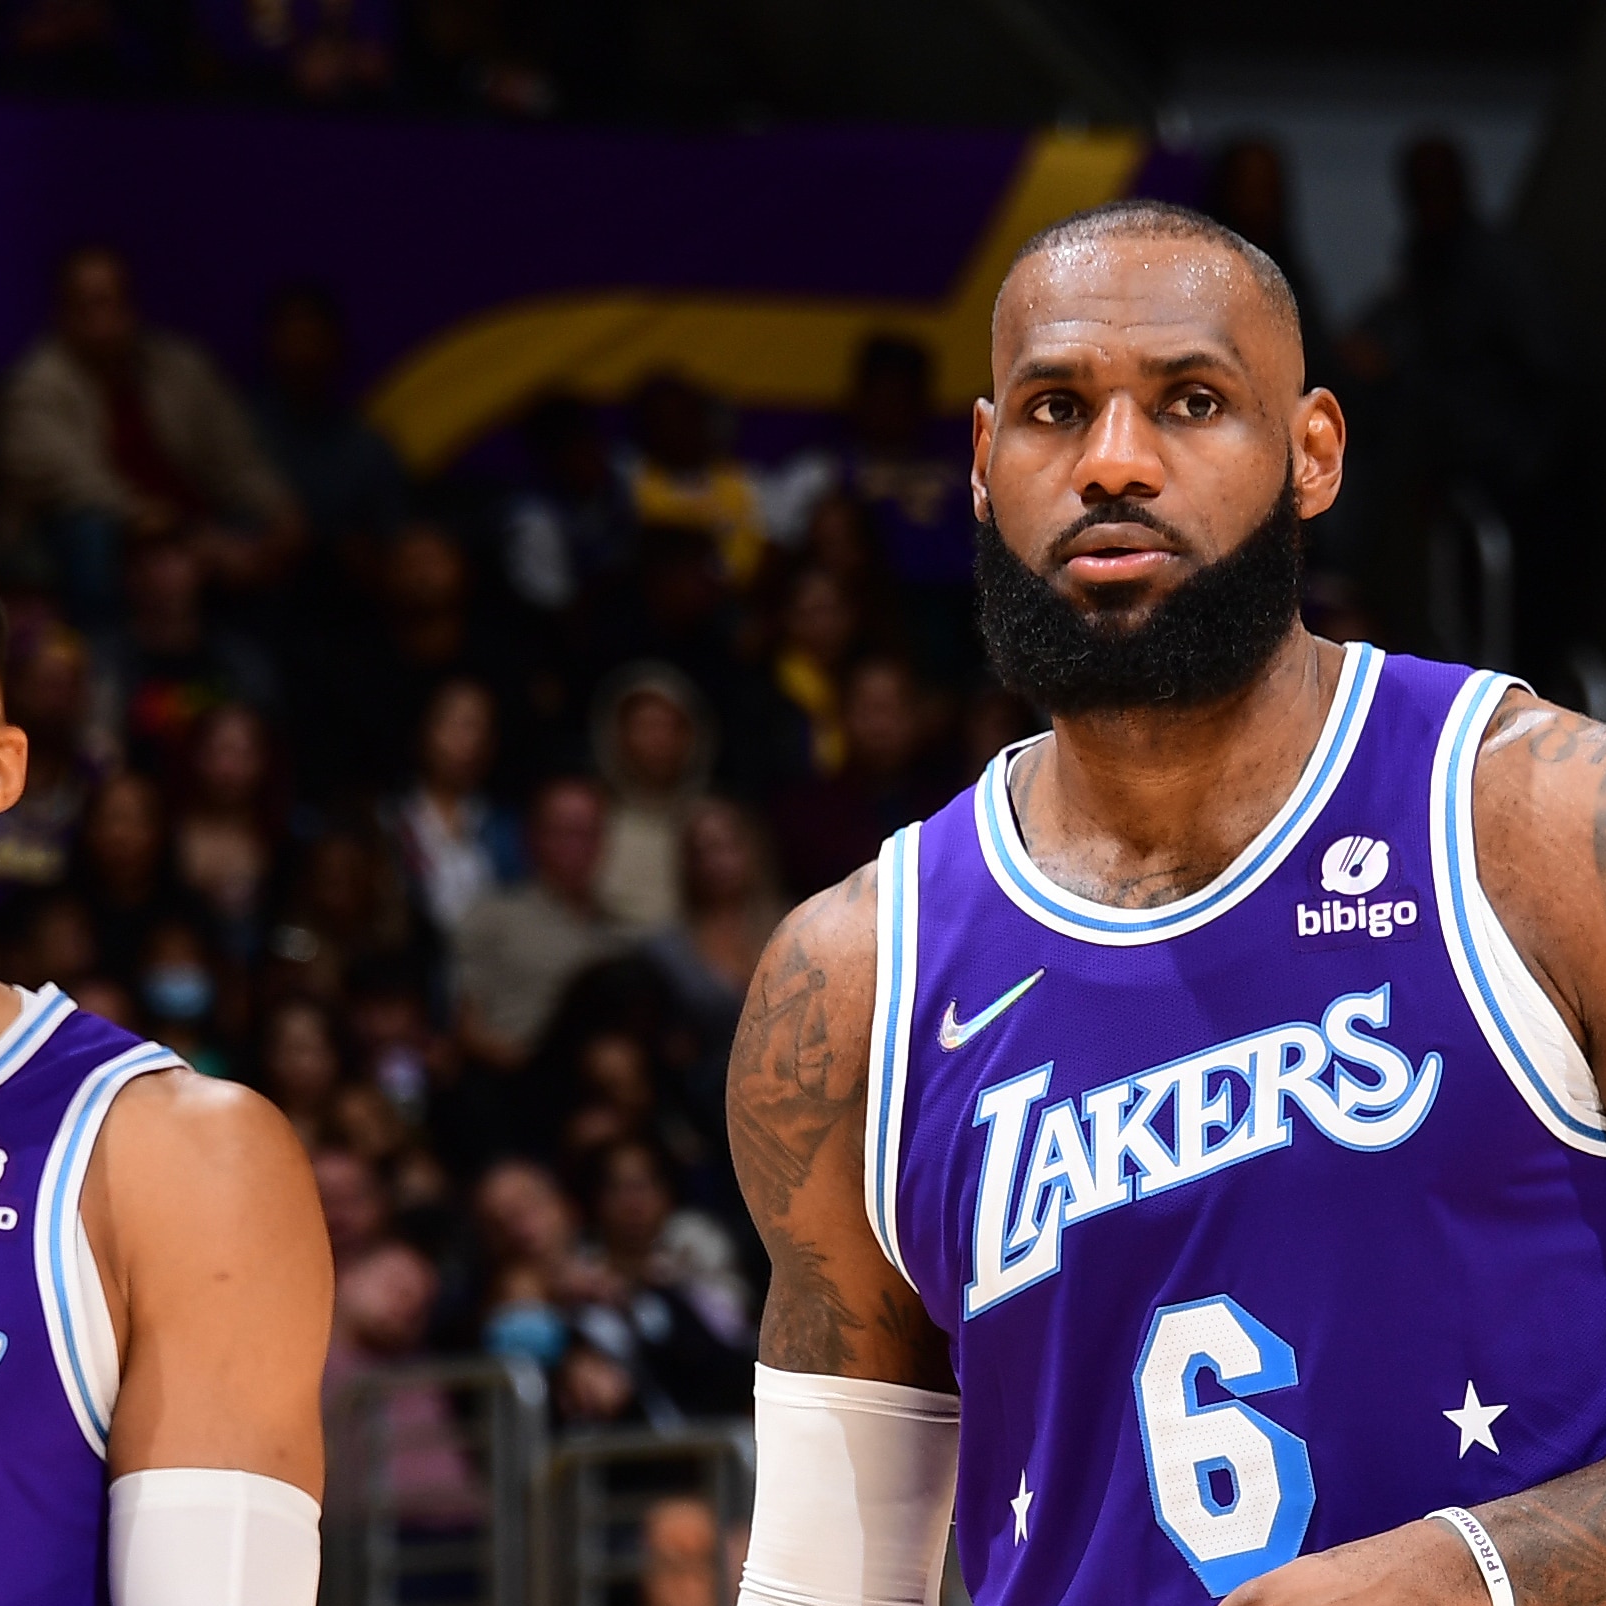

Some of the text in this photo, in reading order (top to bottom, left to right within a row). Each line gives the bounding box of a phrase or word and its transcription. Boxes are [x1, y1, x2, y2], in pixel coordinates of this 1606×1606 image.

[1295, 896, 1418, 939] bibigo
[963, 981, 1444, 1321] LAKERS
[1132, 1293, 1316, 1598] 6
